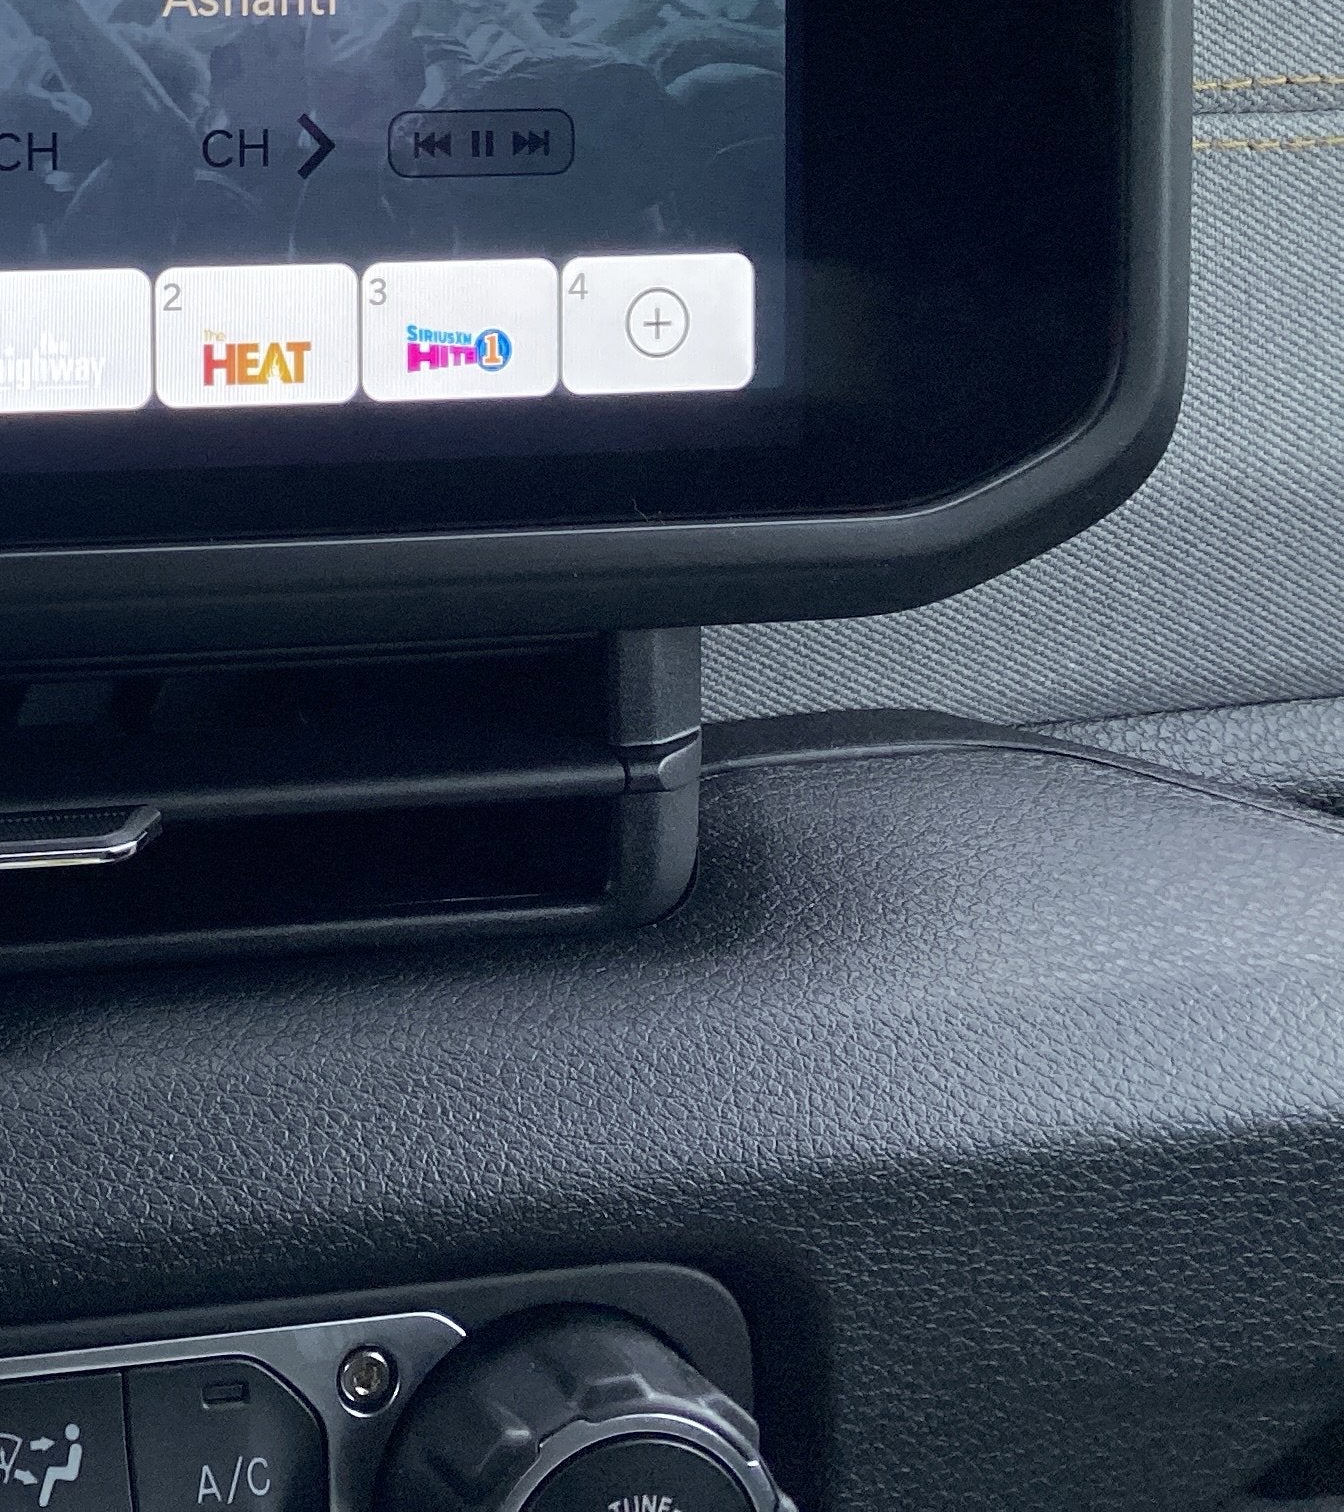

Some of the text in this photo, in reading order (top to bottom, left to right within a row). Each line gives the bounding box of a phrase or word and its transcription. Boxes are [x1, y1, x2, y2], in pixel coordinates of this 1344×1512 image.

[201, 128, 270, 168] CH
[162, 282, 184, 312] 2
[368, 277, 389, 307] 3
[567, 272, 590, 301] 4
[203, 340, 311, 386] HEAT
[197, 1454, 271, 1505] A/C
